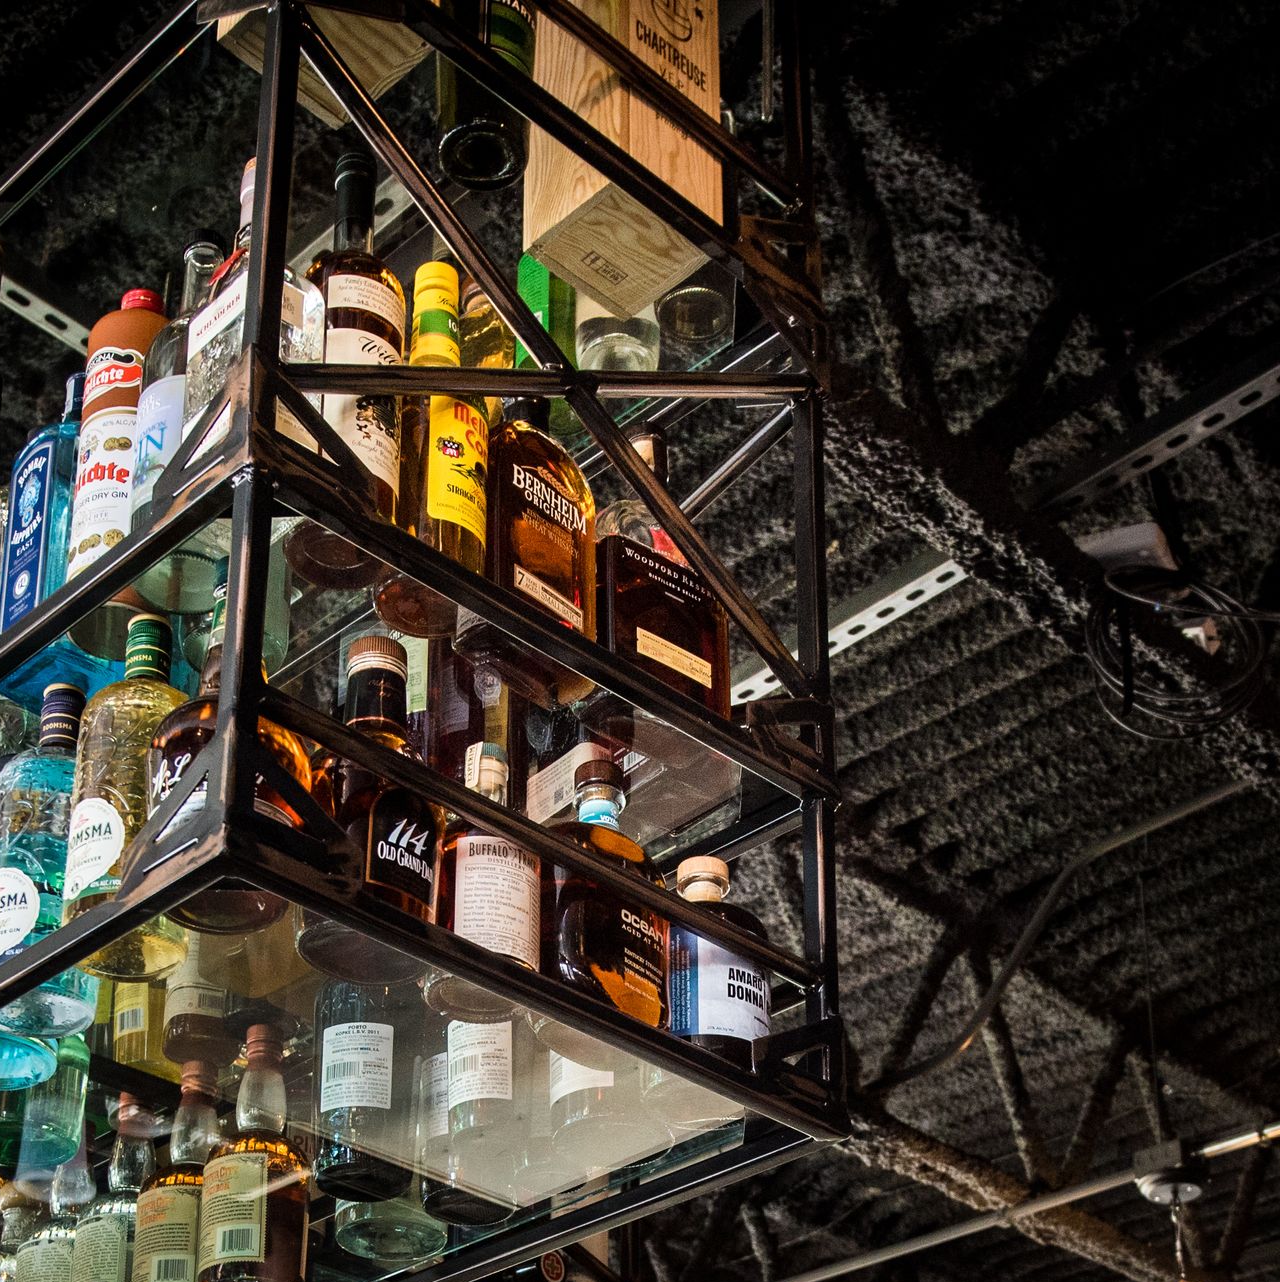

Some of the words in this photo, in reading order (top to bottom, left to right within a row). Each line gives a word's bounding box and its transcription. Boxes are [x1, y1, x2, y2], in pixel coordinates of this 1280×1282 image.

[636, 20, 707, 92] CHARTREUSE
[17, 456, 47, 488] BOMBAY
[111, 491, 129, 500] GIN
[513, 463, 587, 536] BERNHEIM
[525, 490, 574, 531] ORIGINAL
[10, 511, 43, 545] SAPPHIRE
[16, 541, 34, 557] EAST
[624, 547, 679, 580] WOODFORD
[517, 570, 525, 586] 7
[540, 590, 561, 612] SMALL
[562, 606, 583, 628] BATCH
[682, 588, 702, 603] SELECT
[377, 840, 397, 862] OLD
[387, 817, 429, 857] 114
[469, 842, 508, 858] BUFFALO
[487, 857, 526, 872] DISTILLERY
[621, 923, 642, 939] AGED
[644, 936, 652, 946] AT
[728, 966, 764, 994] AMARO
[727, 981, 764, 1011] DONNA
